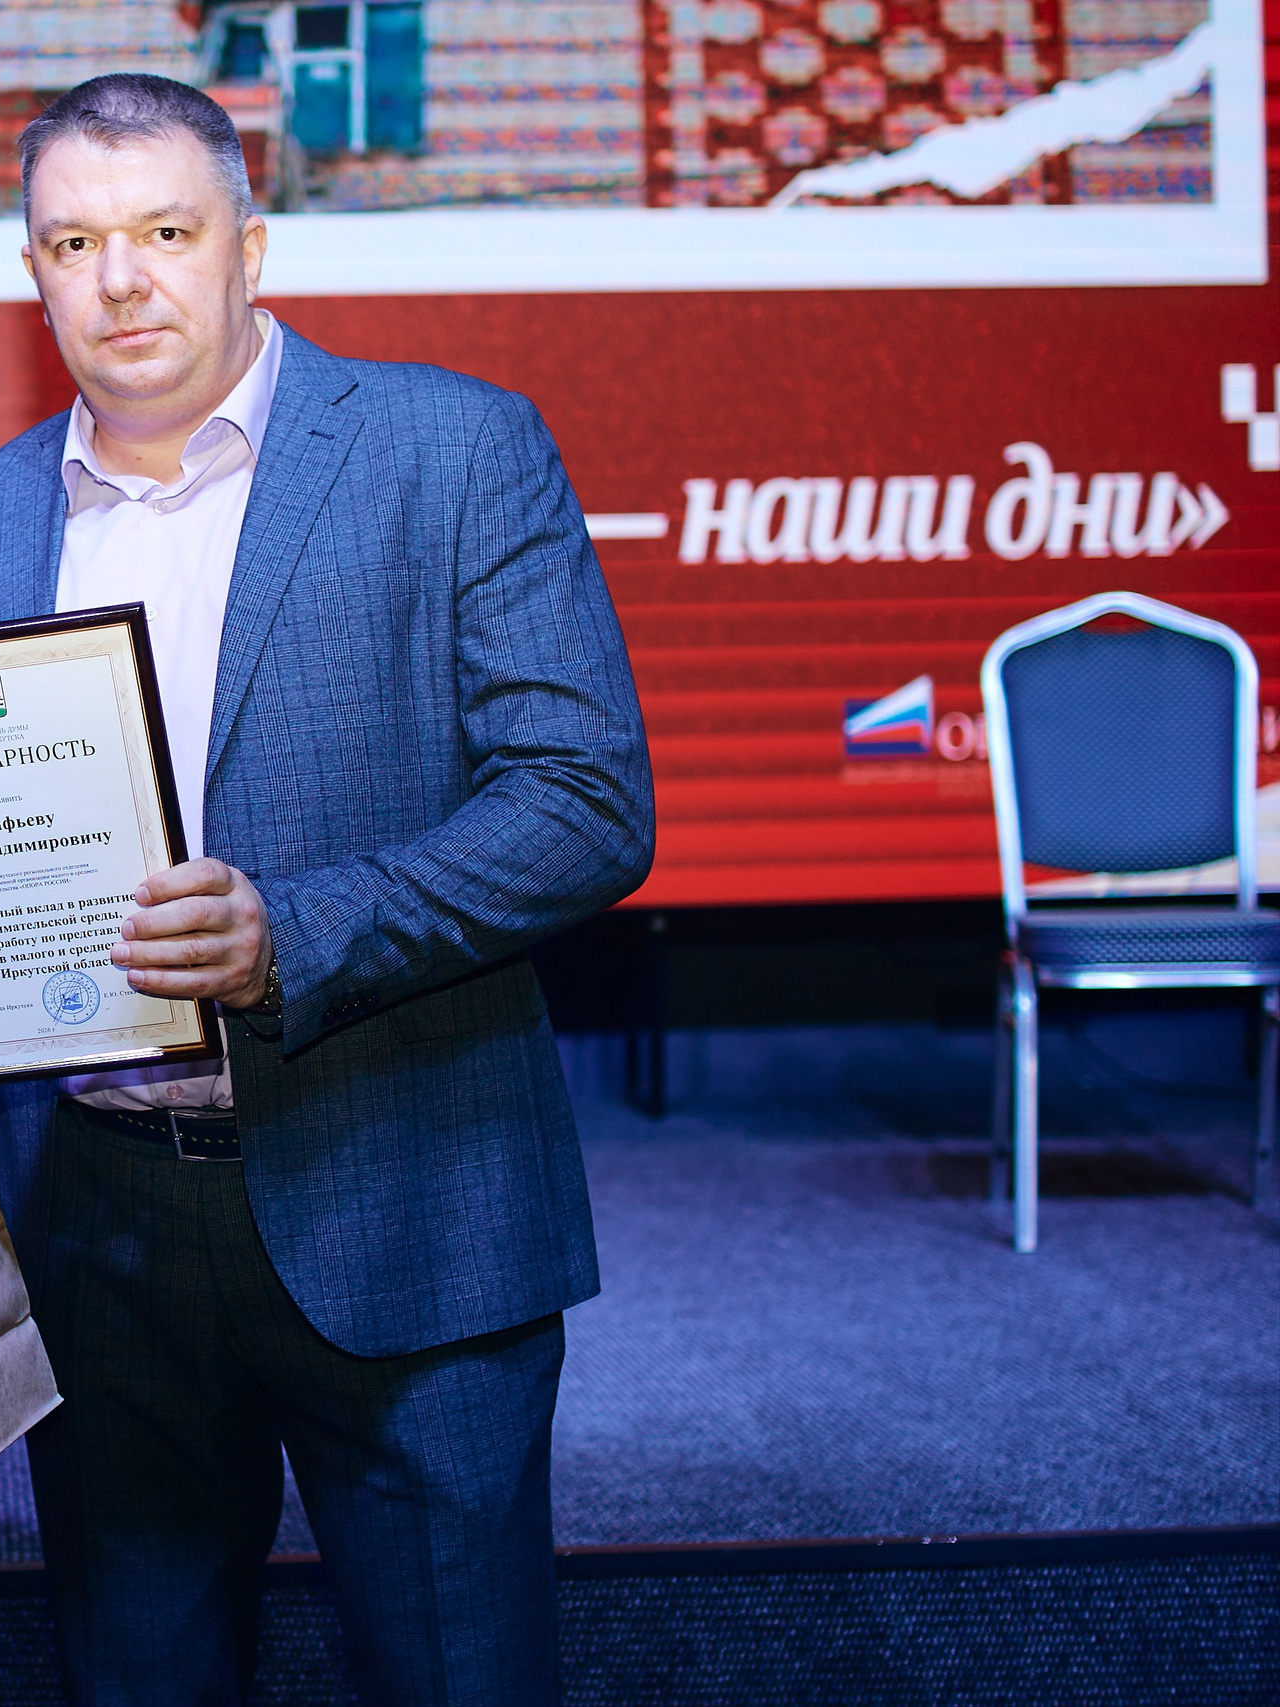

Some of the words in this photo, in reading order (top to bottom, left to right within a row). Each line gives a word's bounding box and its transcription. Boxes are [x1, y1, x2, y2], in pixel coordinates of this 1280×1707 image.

[678, 475, 974, 564] наши
[986, 441, 1229, 560] дни»
[7, 724, 29, 734] ДУМЫ
[26, 902, 65, 914] вклад
[67, 901, 75, 909] в
[78, 893, 136, 911] развитие
[80, 911, 123, 925] среды,
[41, 934, 56, 943] по
[58, 926, 121, 943] представл
[10, 949, 55, 963] малого
[57, 948, 66, 956] и
[0, 960, 71, 980] Иркутской
[73, 954, 114, 973] област
[6, 1003, 33, 1011] Иркутска
